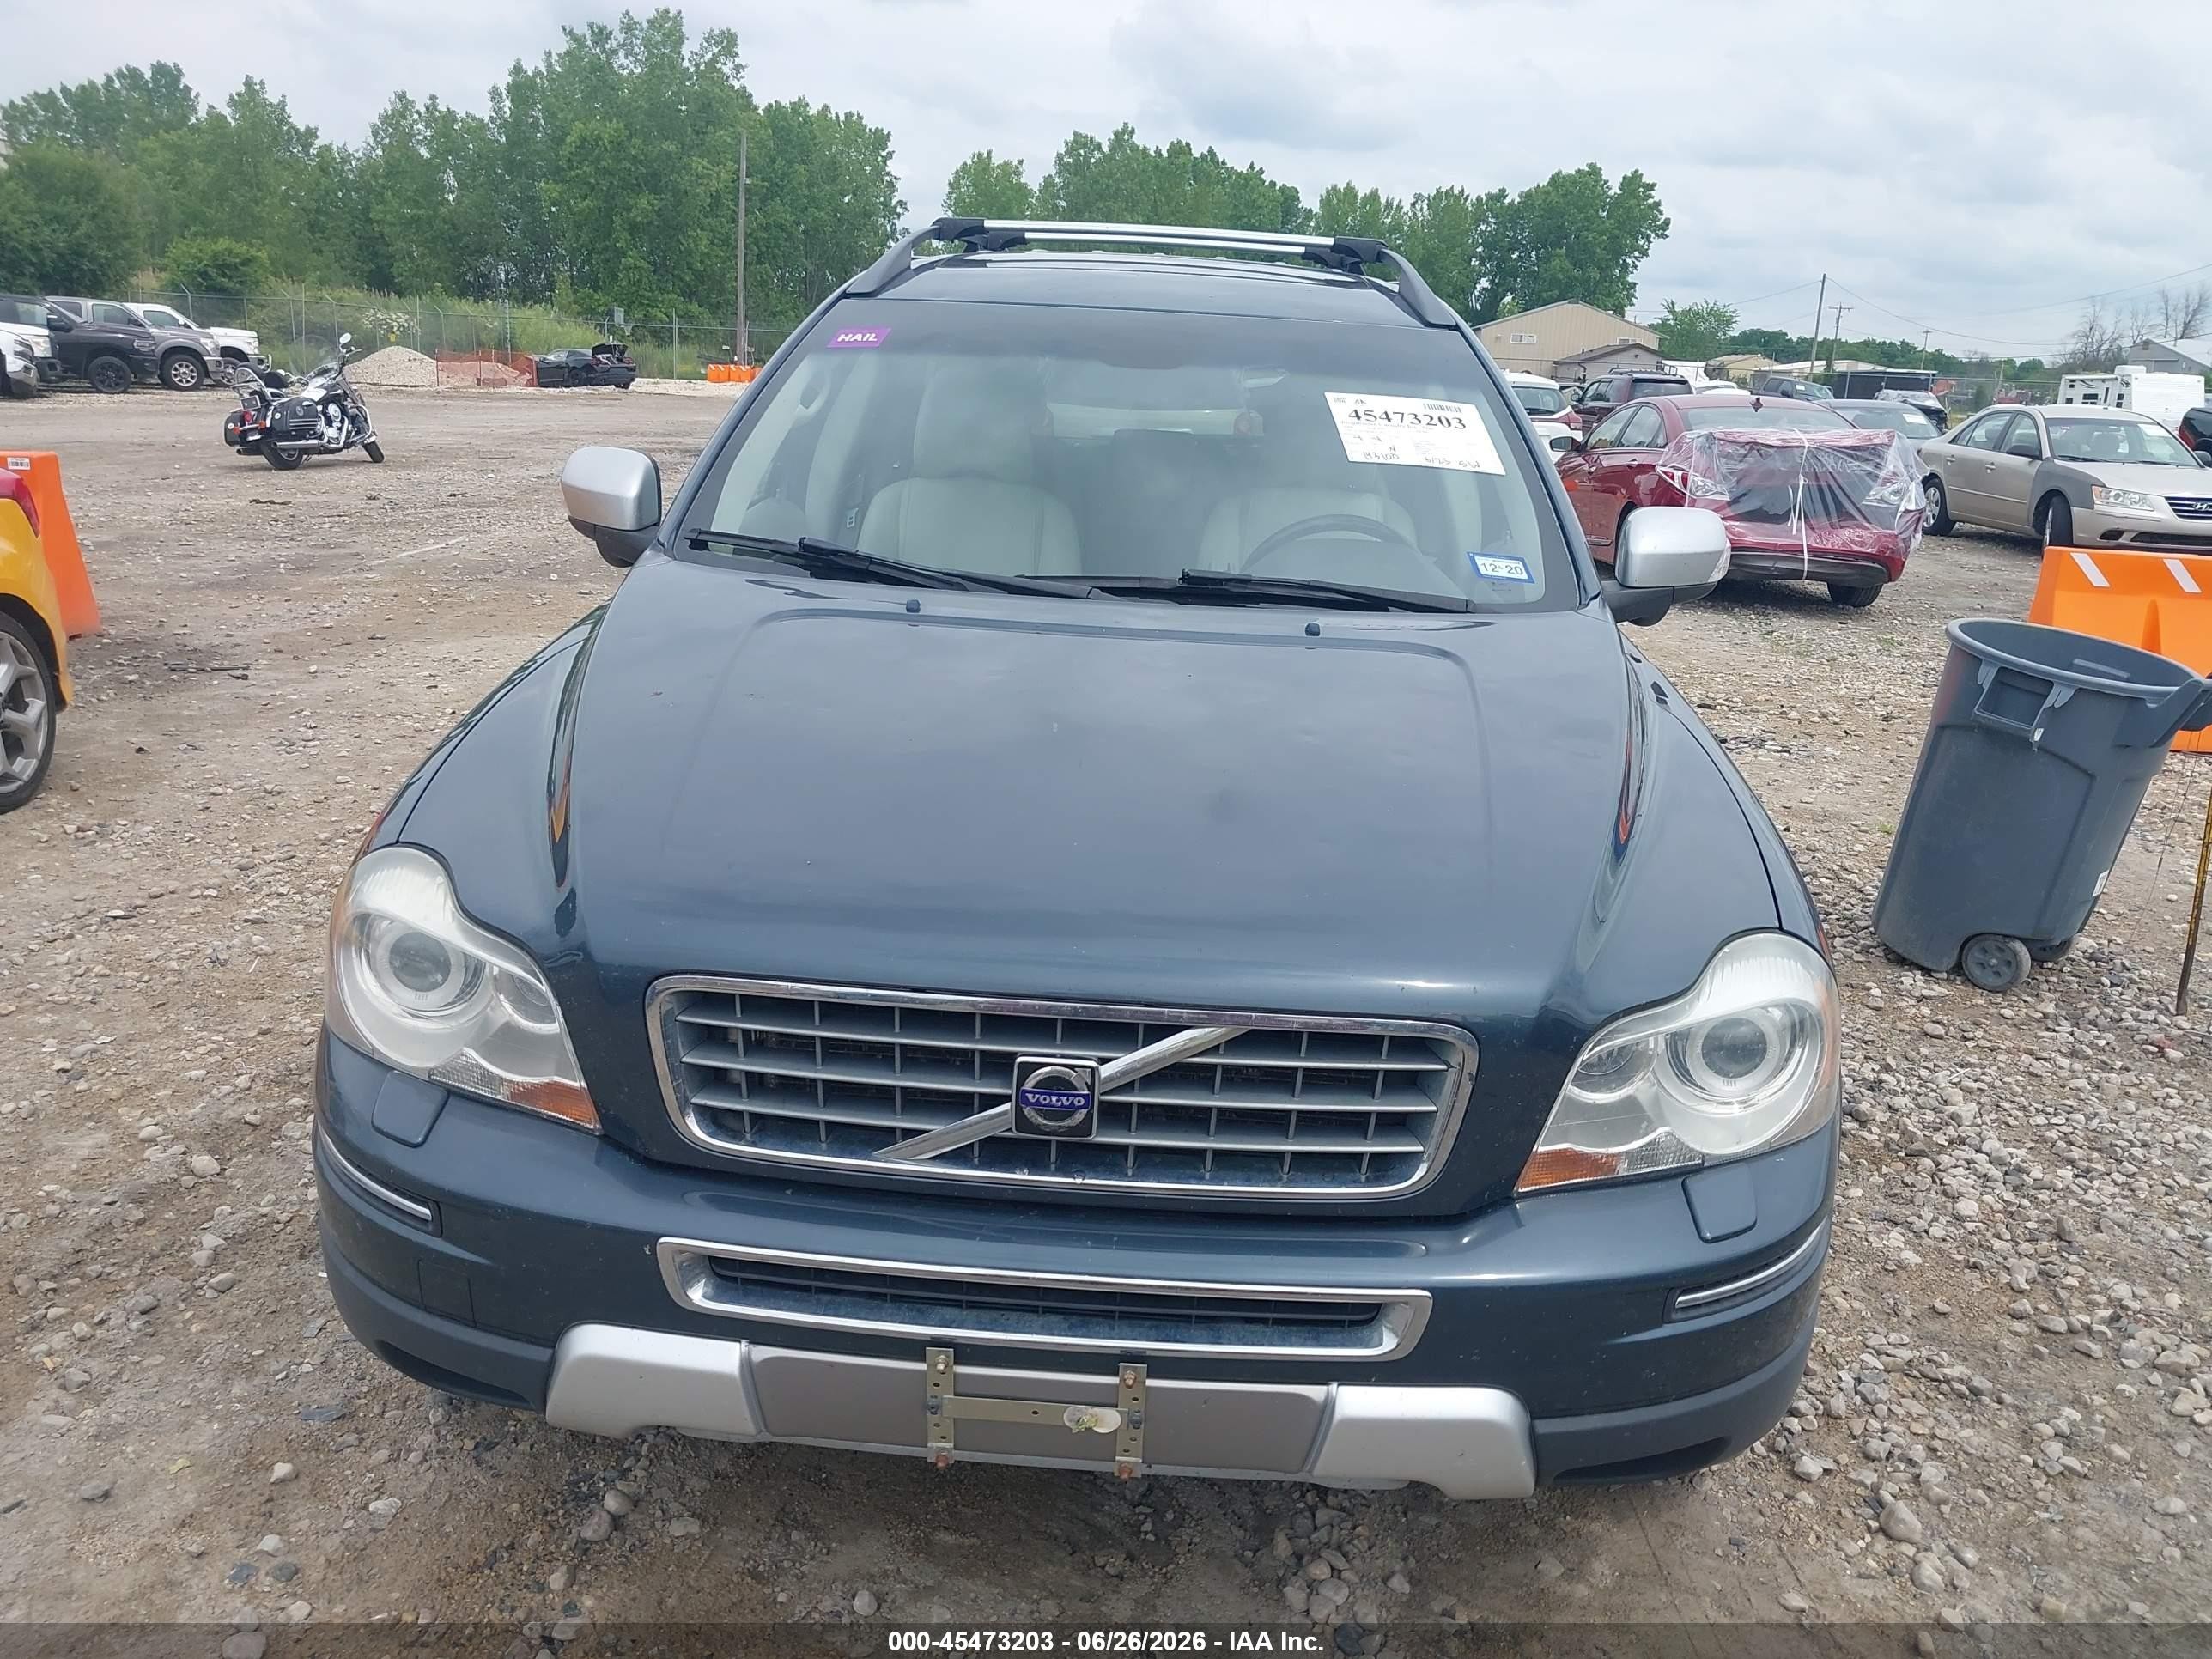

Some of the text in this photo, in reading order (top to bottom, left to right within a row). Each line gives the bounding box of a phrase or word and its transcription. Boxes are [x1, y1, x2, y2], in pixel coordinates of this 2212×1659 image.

[836, 332, 878, 343] HAIL
[1348, 409, 1467, 430] 45473203
[1024, 1092, 1085, 1107] VOLVO
